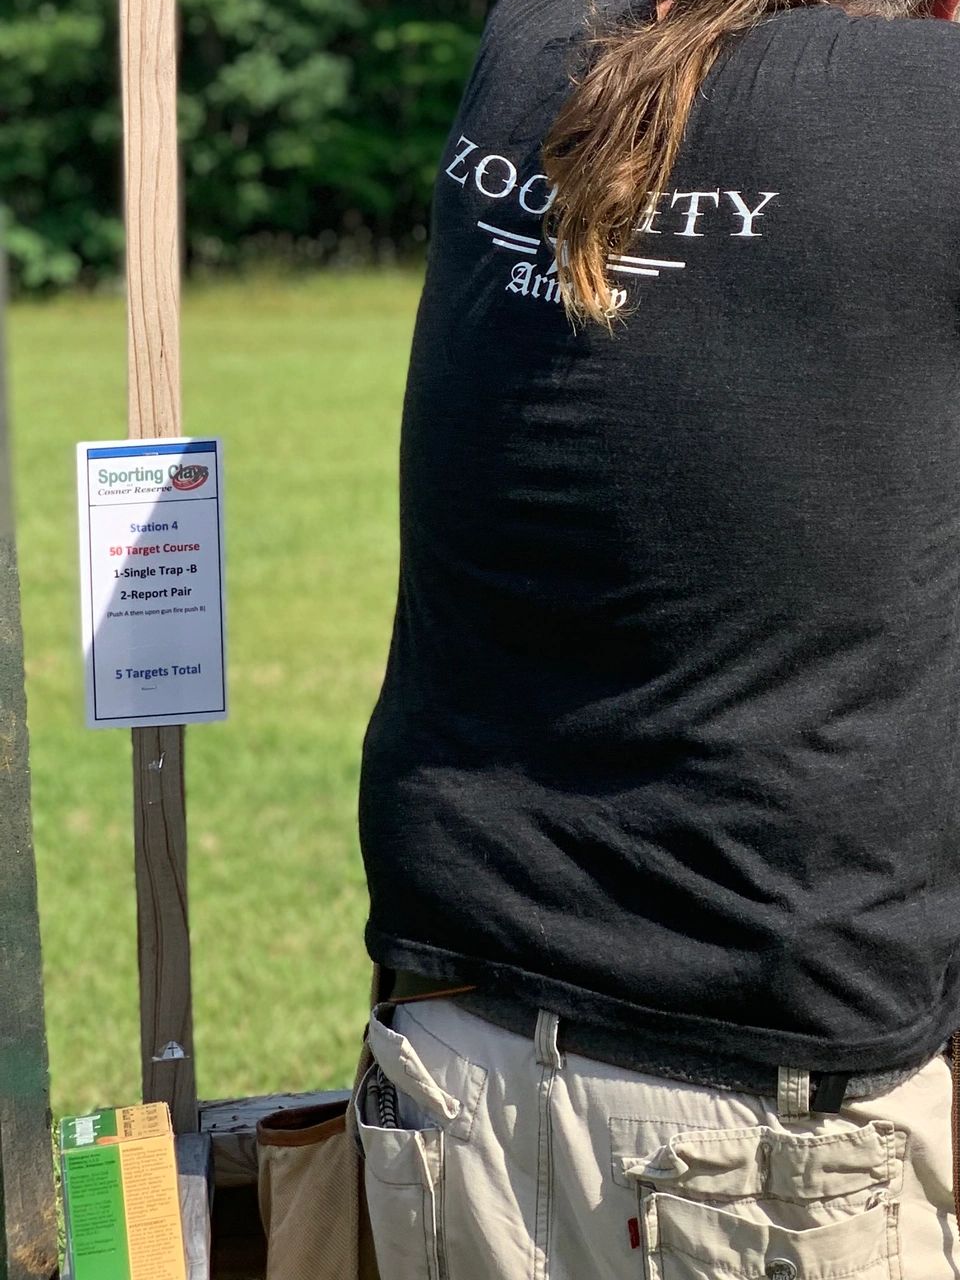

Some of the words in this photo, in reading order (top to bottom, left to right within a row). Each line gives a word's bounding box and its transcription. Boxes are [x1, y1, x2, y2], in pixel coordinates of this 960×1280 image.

[632, 188, 780, 236] ITY
[98, 467, 164, 486] Sporting
[168, 464, 208, 482] Clays
[98, 488, 132, 496] Cosner
[134, 486, 172, 494] Reserve
[130, 522, 168, 532] Station
[171, 520, 178, 530] 4
[109, 546, 122, 556] 50
[126, 545, 160, 556] Target
[163, 543, 200, 552] Course
[114, 566, 156, 578] 1-Single
[159, 566, 184, 576] Trap
[186, 564, 198, 574] -B
[120, 588, 168, 600] 2-Report
[171, 586, 192, 596] Pair
[116, 670, 122, 680] 5
[126, 668, 168, 680] Targets
[172, 664, 201, 675] Total
